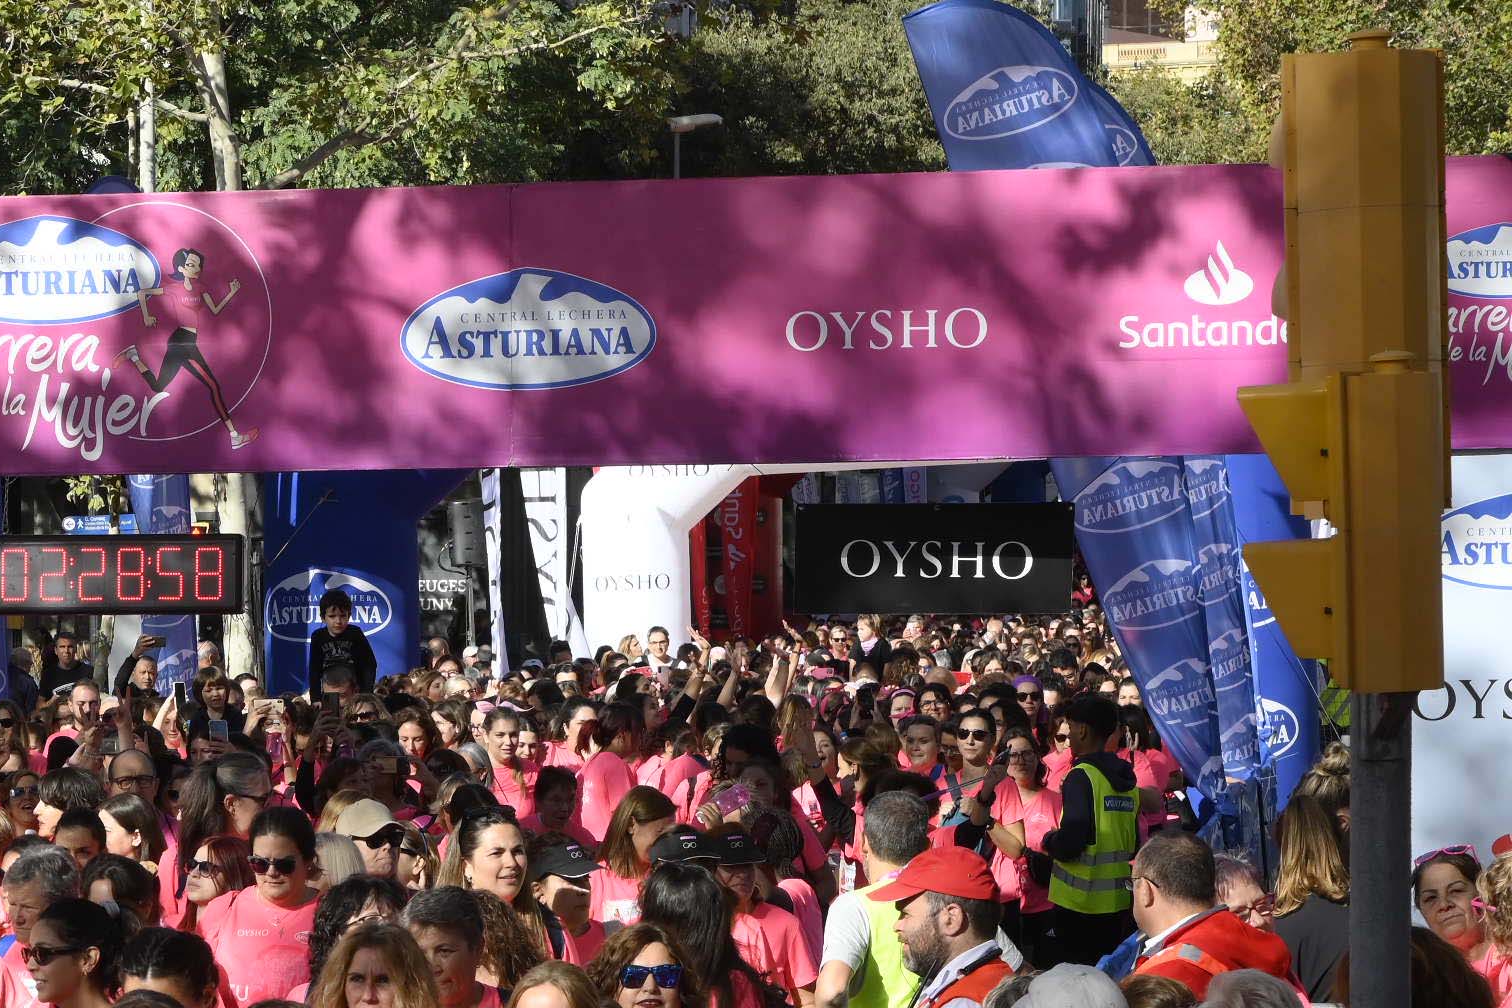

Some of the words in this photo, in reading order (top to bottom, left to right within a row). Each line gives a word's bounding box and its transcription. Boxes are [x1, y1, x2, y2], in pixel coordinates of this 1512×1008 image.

[460, 310, 539, 324] CENTRAL
[546, 307, 628, 321] LECHERA
[785, 306, 989, 352] OYSHO
[420, 316, 637, 360] ASTURIANA
[2, 375, 26, 416] la
[21, 367, 171, 462] Mujer
[0, 546, 223, 601] 02:28:58
[840, 538, 1034, 581] OYSHO
[595, 573, 670, 591] OYSHO
